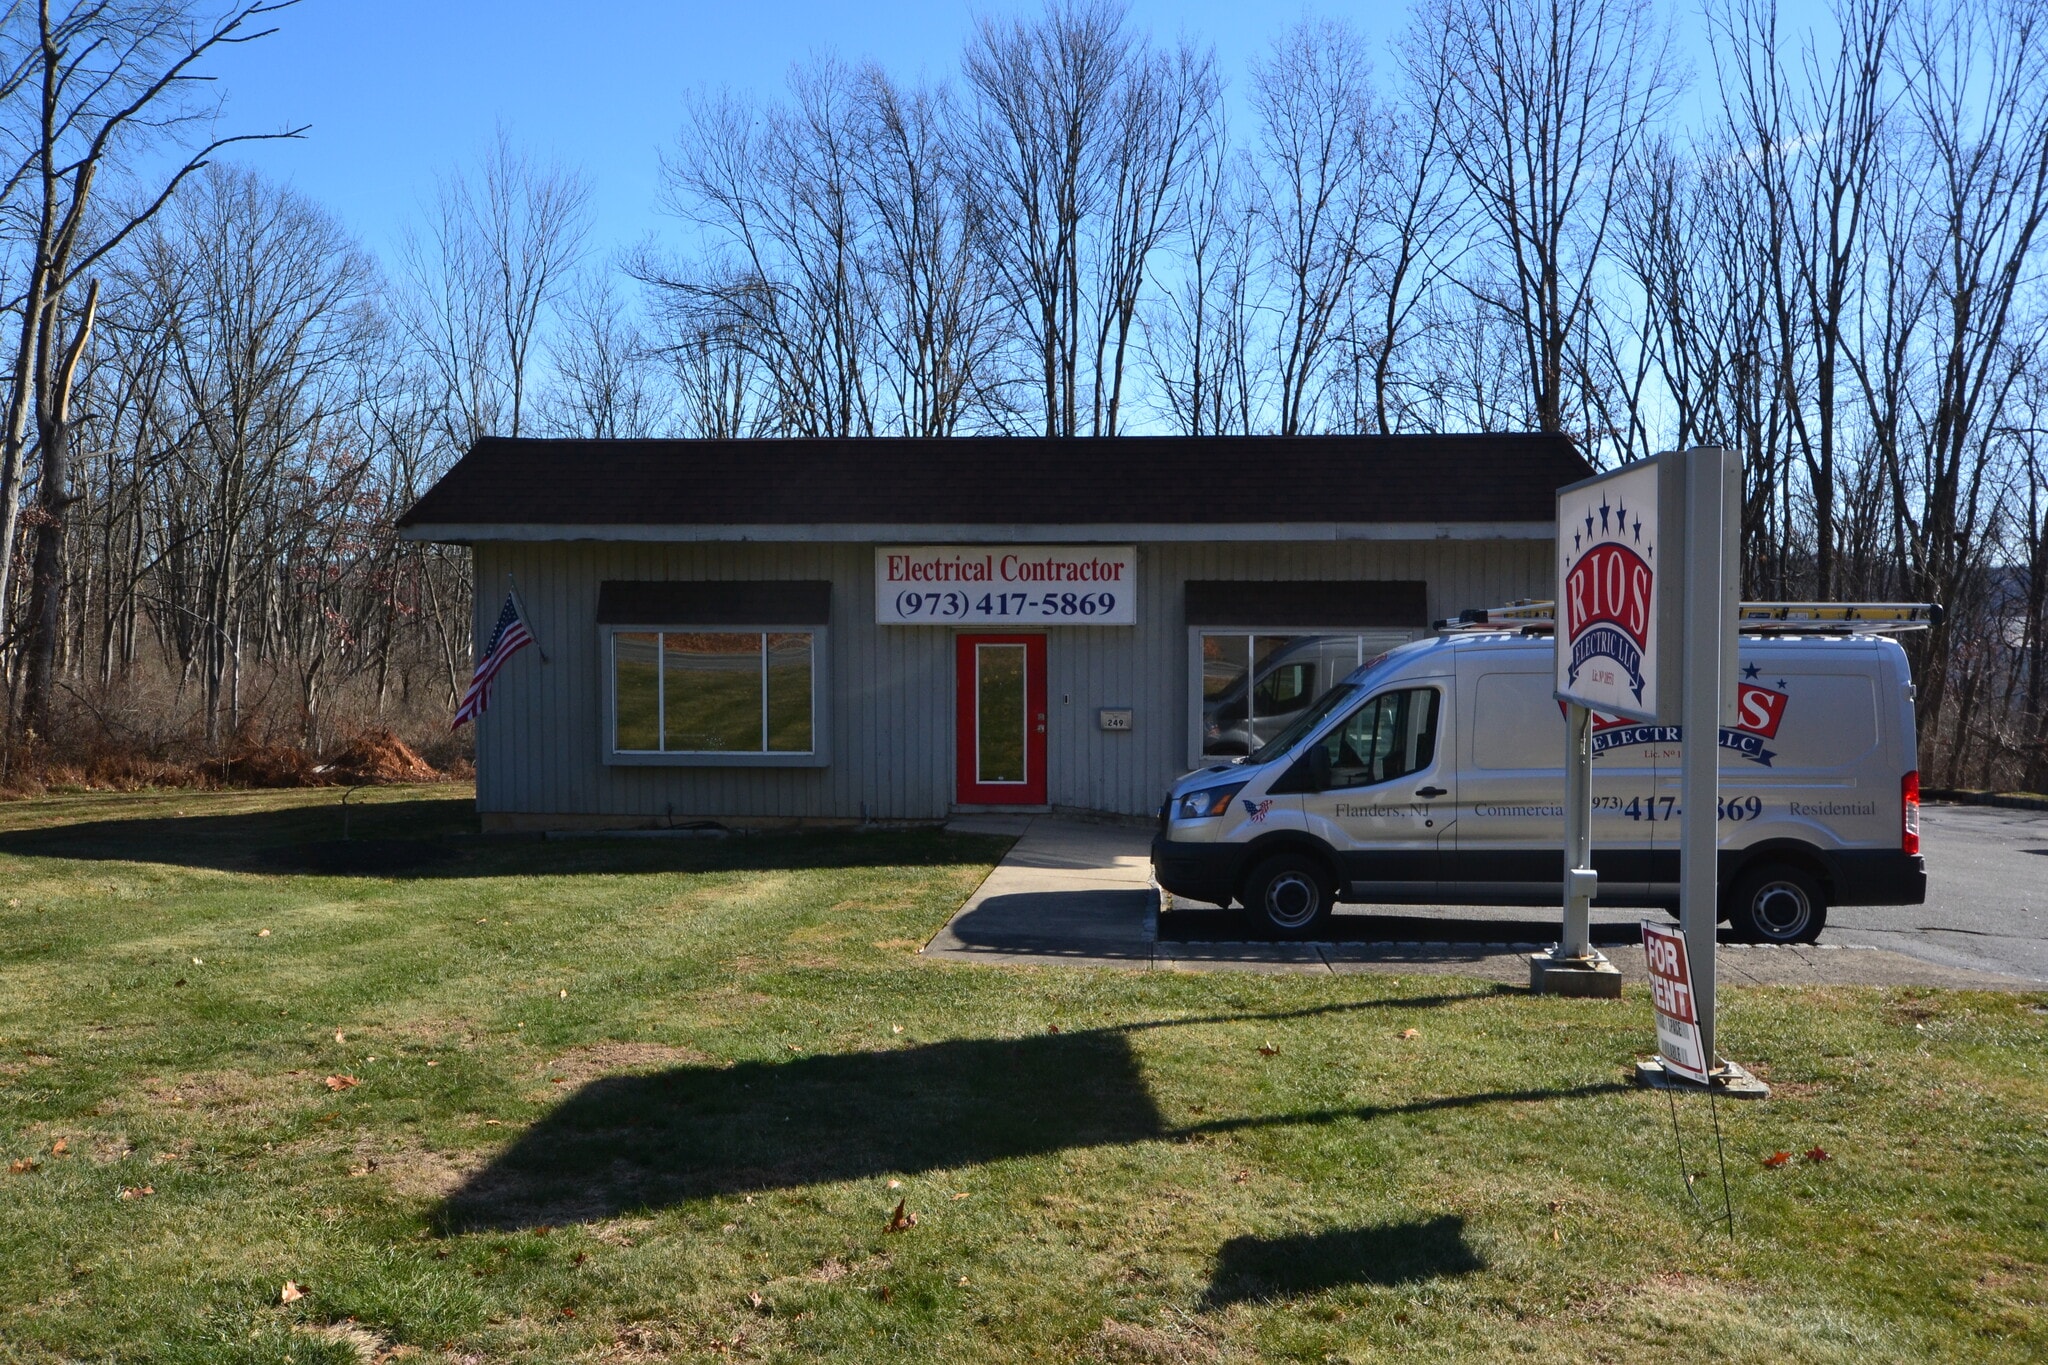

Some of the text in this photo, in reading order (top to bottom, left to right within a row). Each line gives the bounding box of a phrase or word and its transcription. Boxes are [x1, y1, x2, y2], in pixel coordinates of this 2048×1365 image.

[886, 554, 1125, 582] Electrical Contractor
[895, 590, 1116, 619] (973) 417-5869
[1569, 550, 1648, 636] RIOS
[1575, 631, 1638, 676] ELECTRIC LLC
[1107, 719, 1124, 727] 249
[1593, 727, 1679, 751] ELECTR
[1335, 802, 1431, 819] Flanders, NJ
[1474, 803, 1564, 817] Commercia
[1592, 796, 1624, 810] 973)
[1789, 800, 1876, 816] Residential
[1647, 936, 1680, 977] FOR
